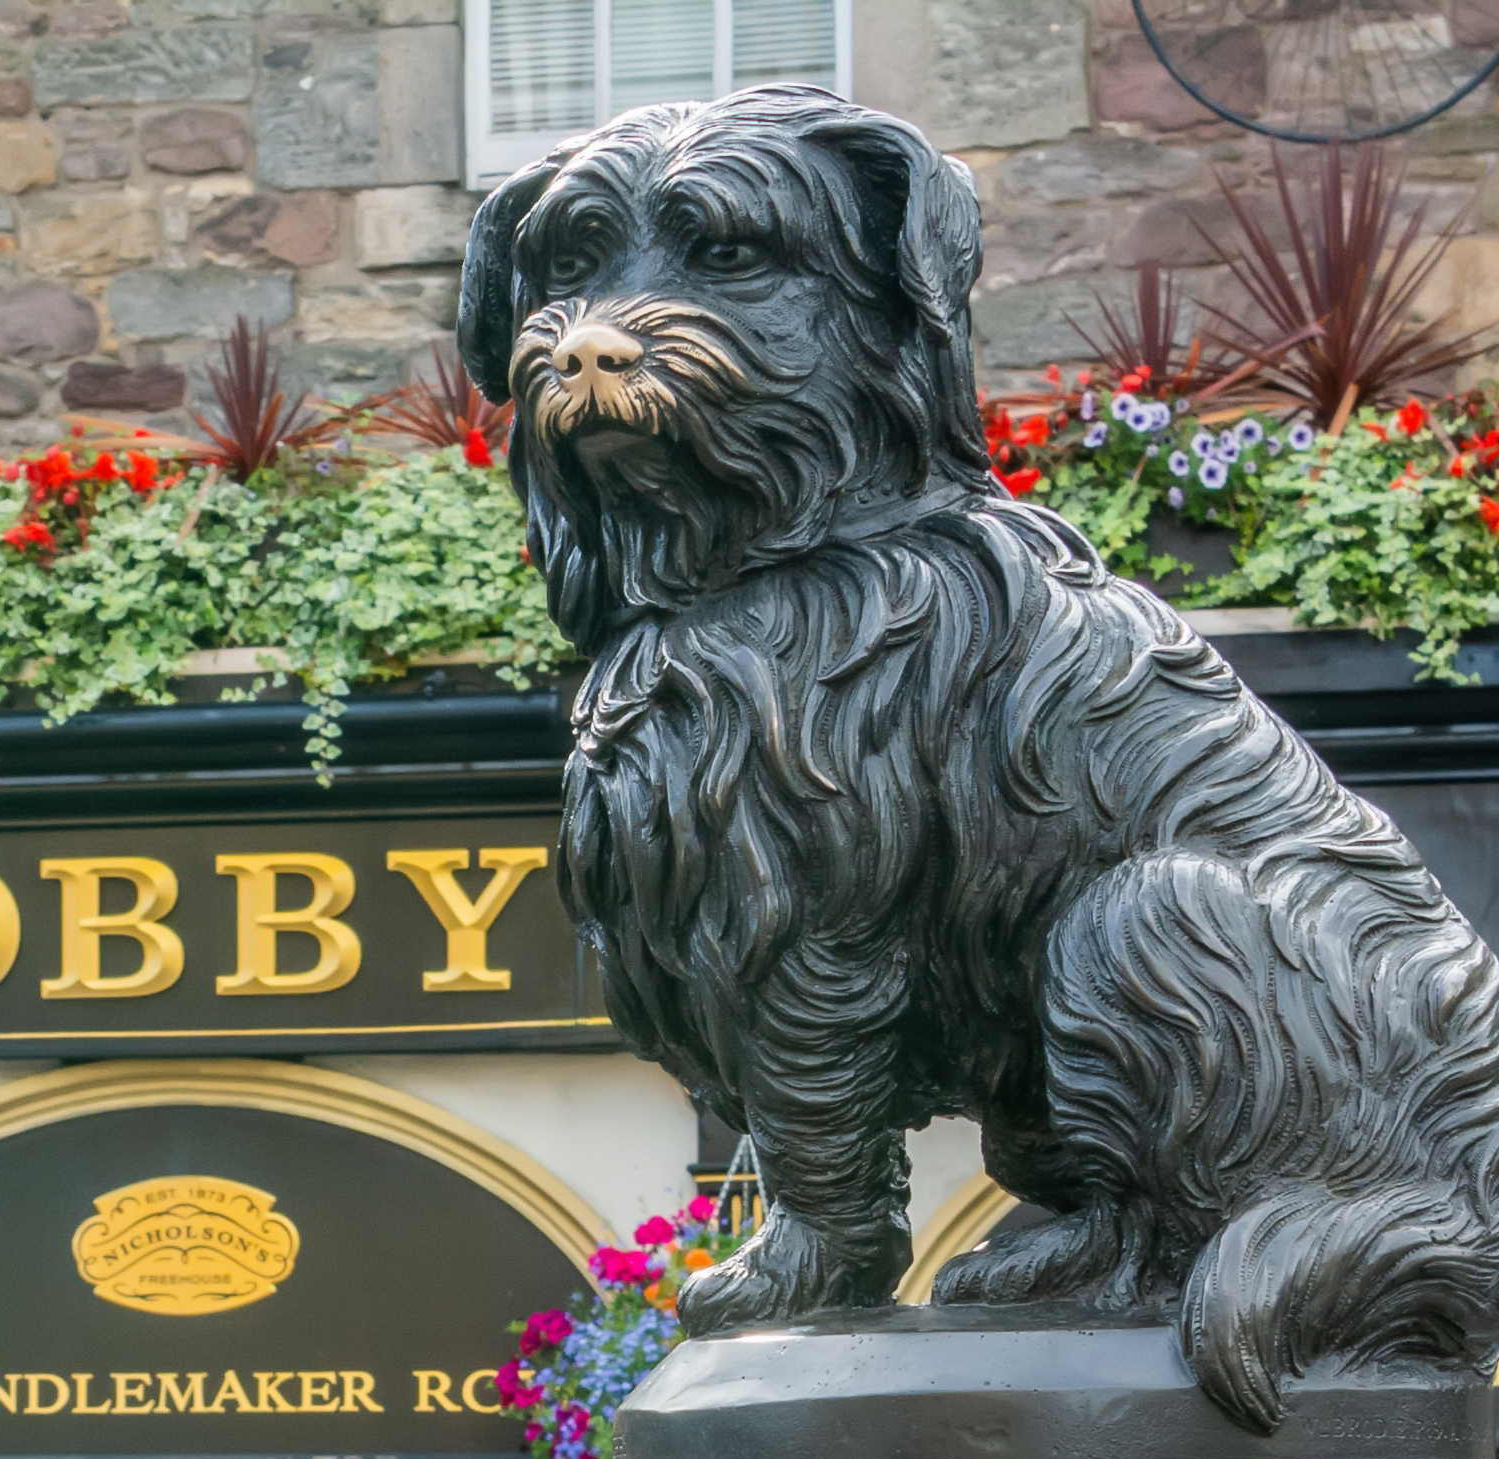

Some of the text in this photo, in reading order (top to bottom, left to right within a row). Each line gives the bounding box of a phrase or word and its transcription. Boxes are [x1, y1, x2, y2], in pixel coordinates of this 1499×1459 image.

[188, 1188, 226, 1203] 1873
[103, 1225, 272, 1266] NICHOLSON'S
[138, 1274, 232, 1285] FREEHOUSE
[412, 1368, 536, 1414] RO
